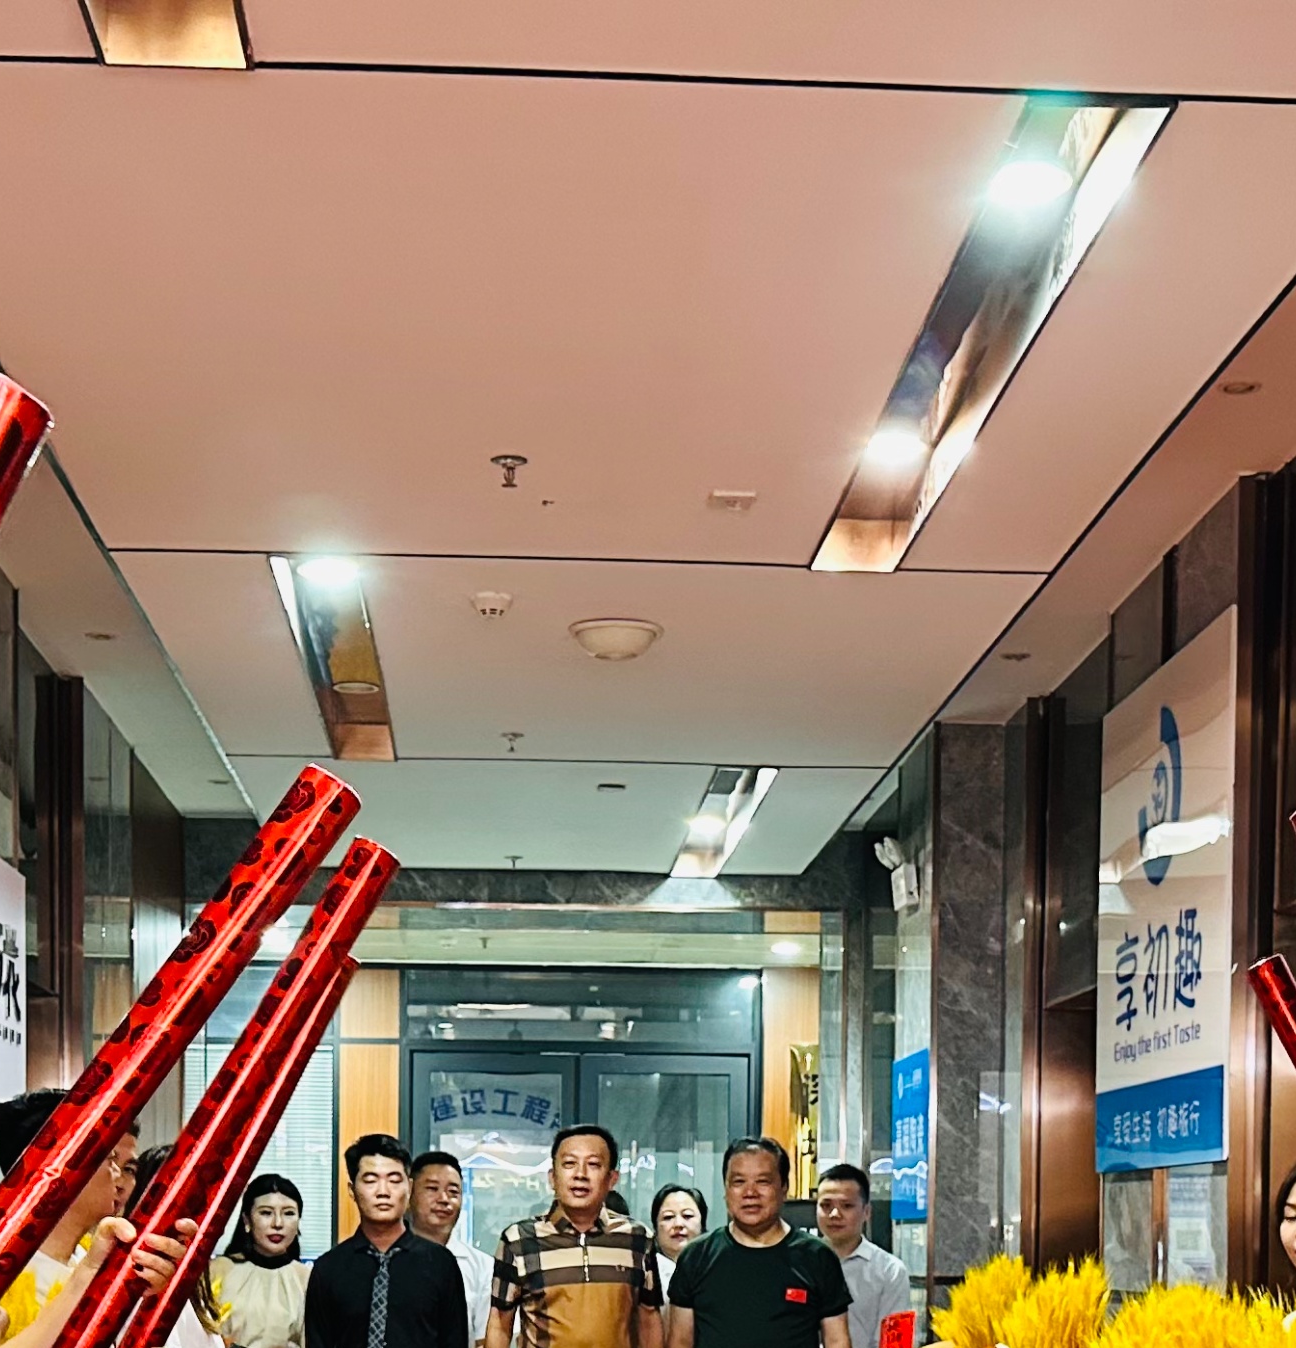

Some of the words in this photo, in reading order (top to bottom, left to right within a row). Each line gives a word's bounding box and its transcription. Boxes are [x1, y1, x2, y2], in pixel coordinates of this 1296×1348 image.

[1116, 908, 1203, 1032] 享初趣
[1114, 1040, 1137, 1064] Enjoy
[1138, 1035, 1152, 1056] the
[1153, 1028, 1172, 1053] first
